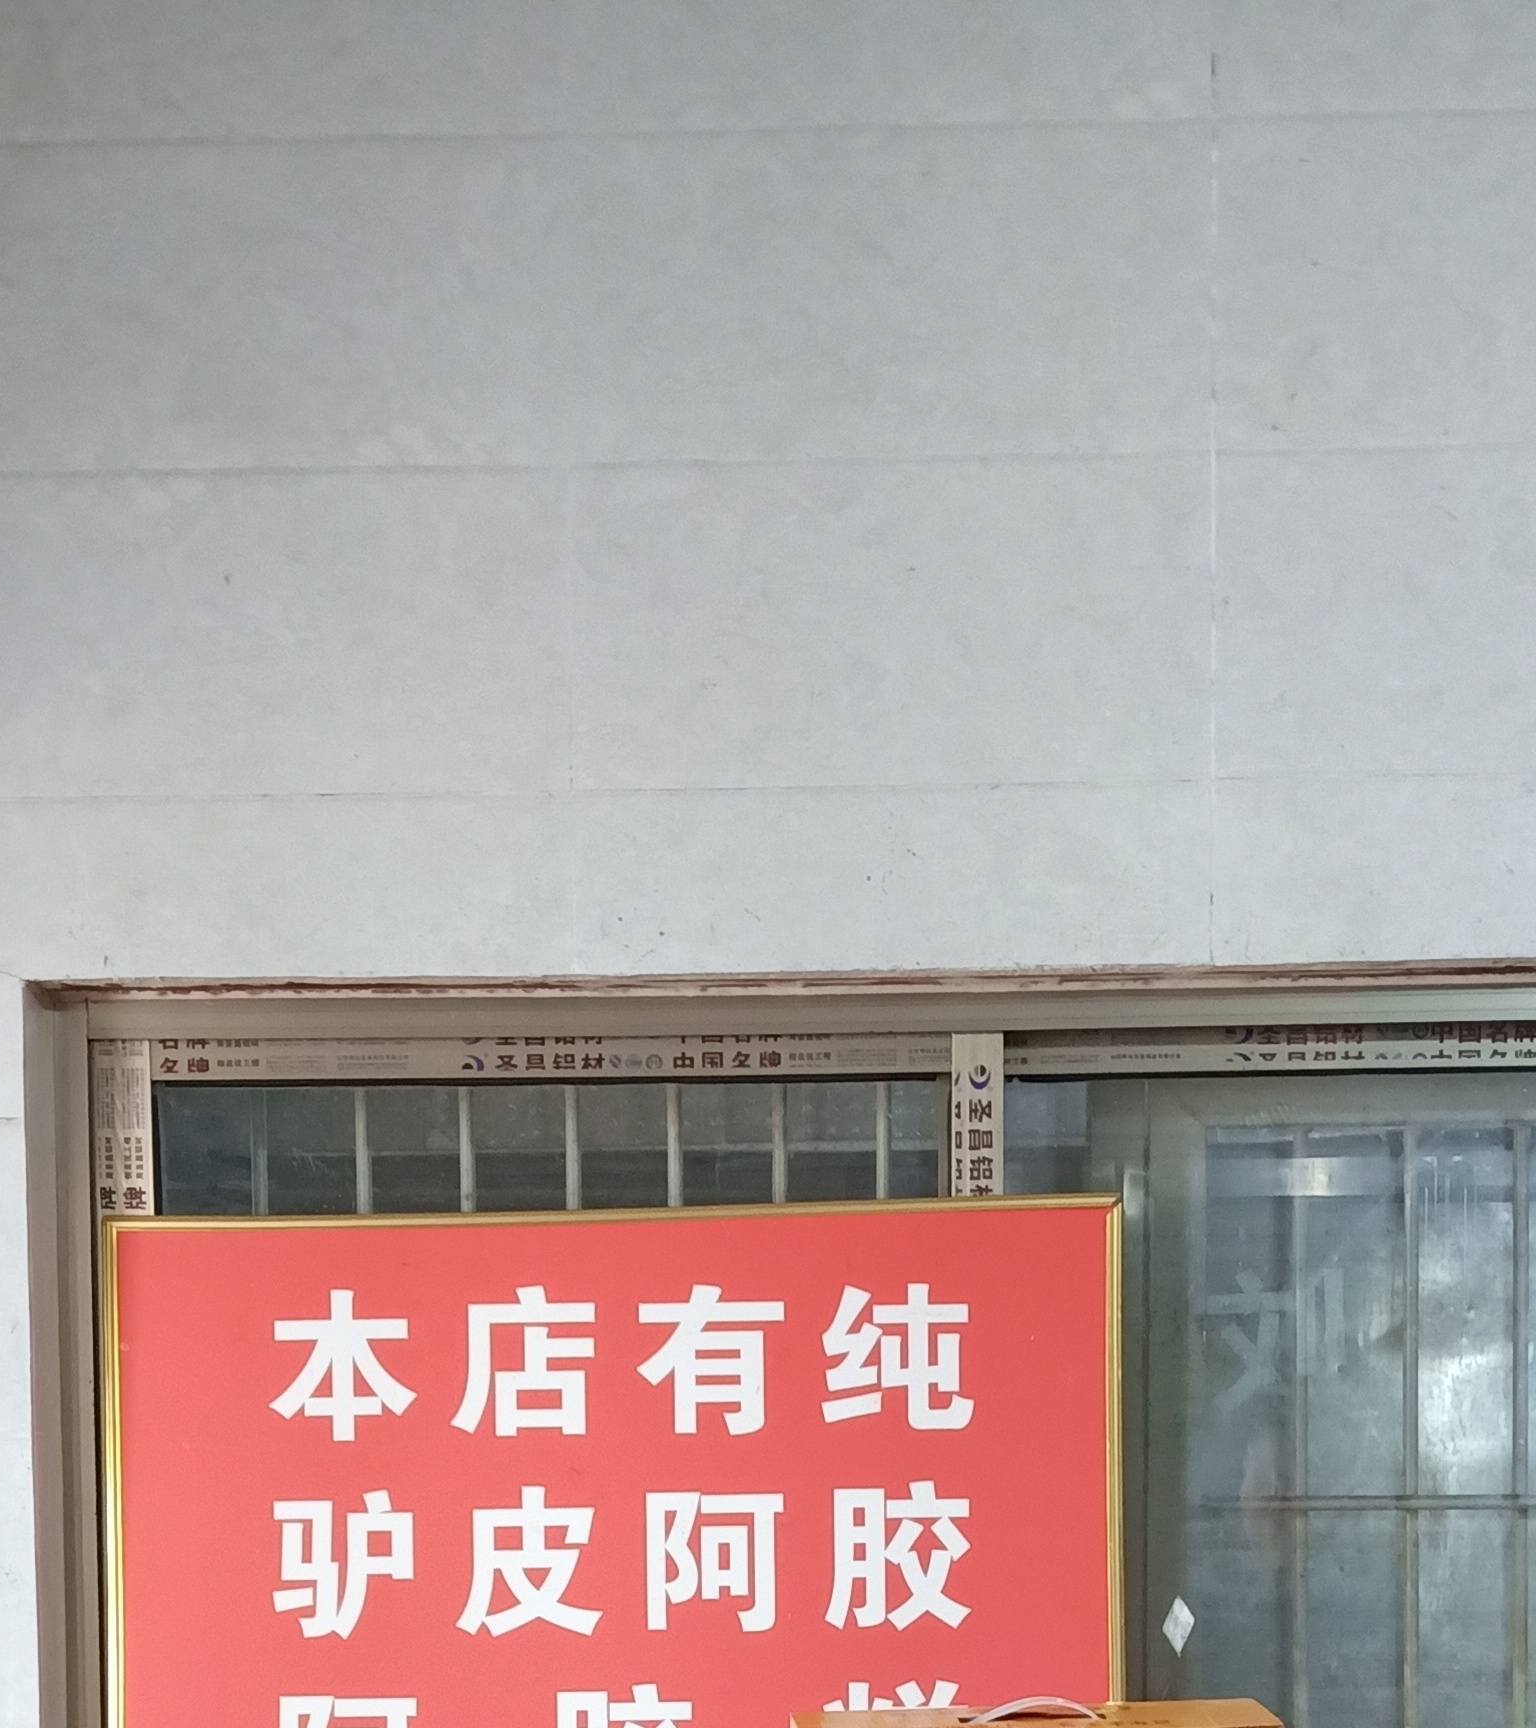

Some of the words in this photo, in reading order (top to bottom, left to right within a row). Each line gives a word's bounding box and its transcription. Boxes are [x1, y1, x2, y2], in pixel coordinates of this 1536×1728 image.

[270, 1283, 975, 1442] 本店有纯
[272, 1481, 972, 1640] 驴皮阿胶
